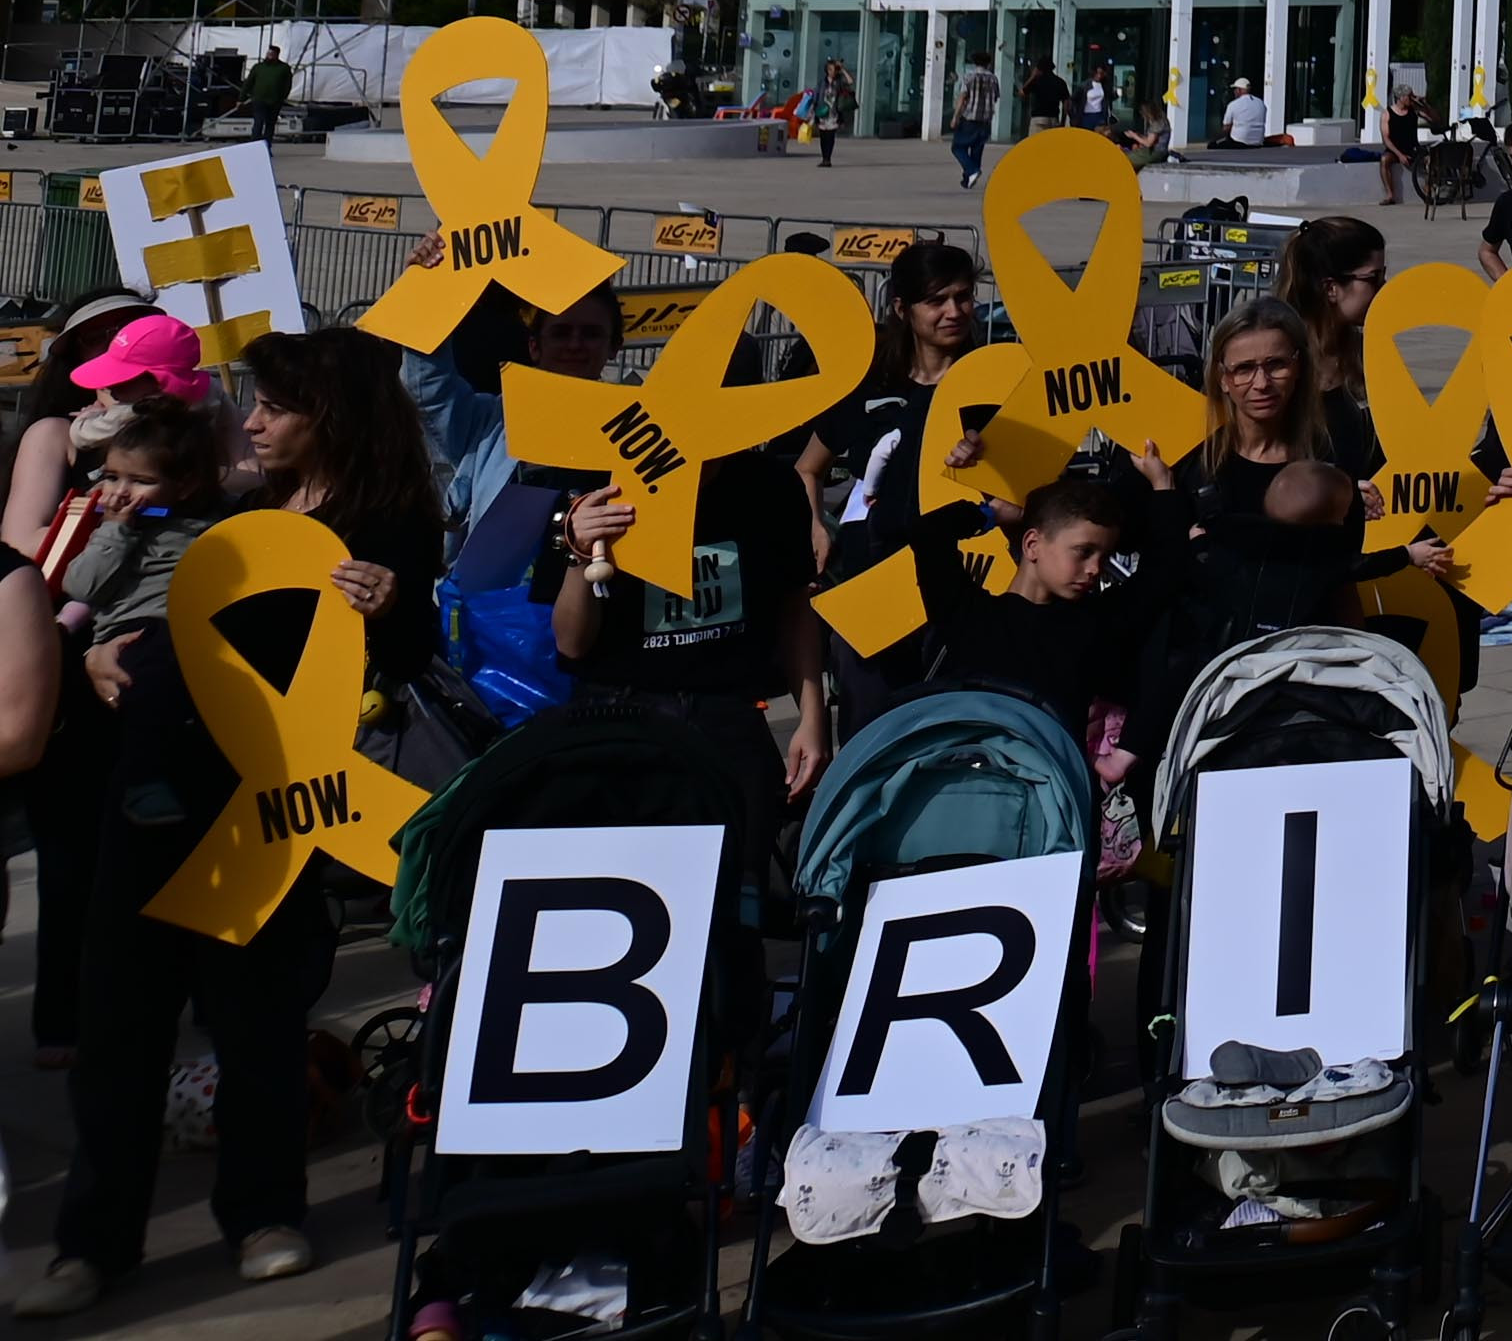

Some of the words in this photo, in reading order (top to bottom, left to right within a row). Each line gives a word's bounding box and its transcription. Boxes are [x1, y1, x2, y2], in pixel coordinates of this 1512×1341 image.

[452, 217, 529, 270] NOW.
[1045, 357, 1131, 416] NOW.
[602, 402, 686, 494] NOW.
[1392, 472, 1465, 515] NOW.
[257, 771, 362, 845] NOW.
